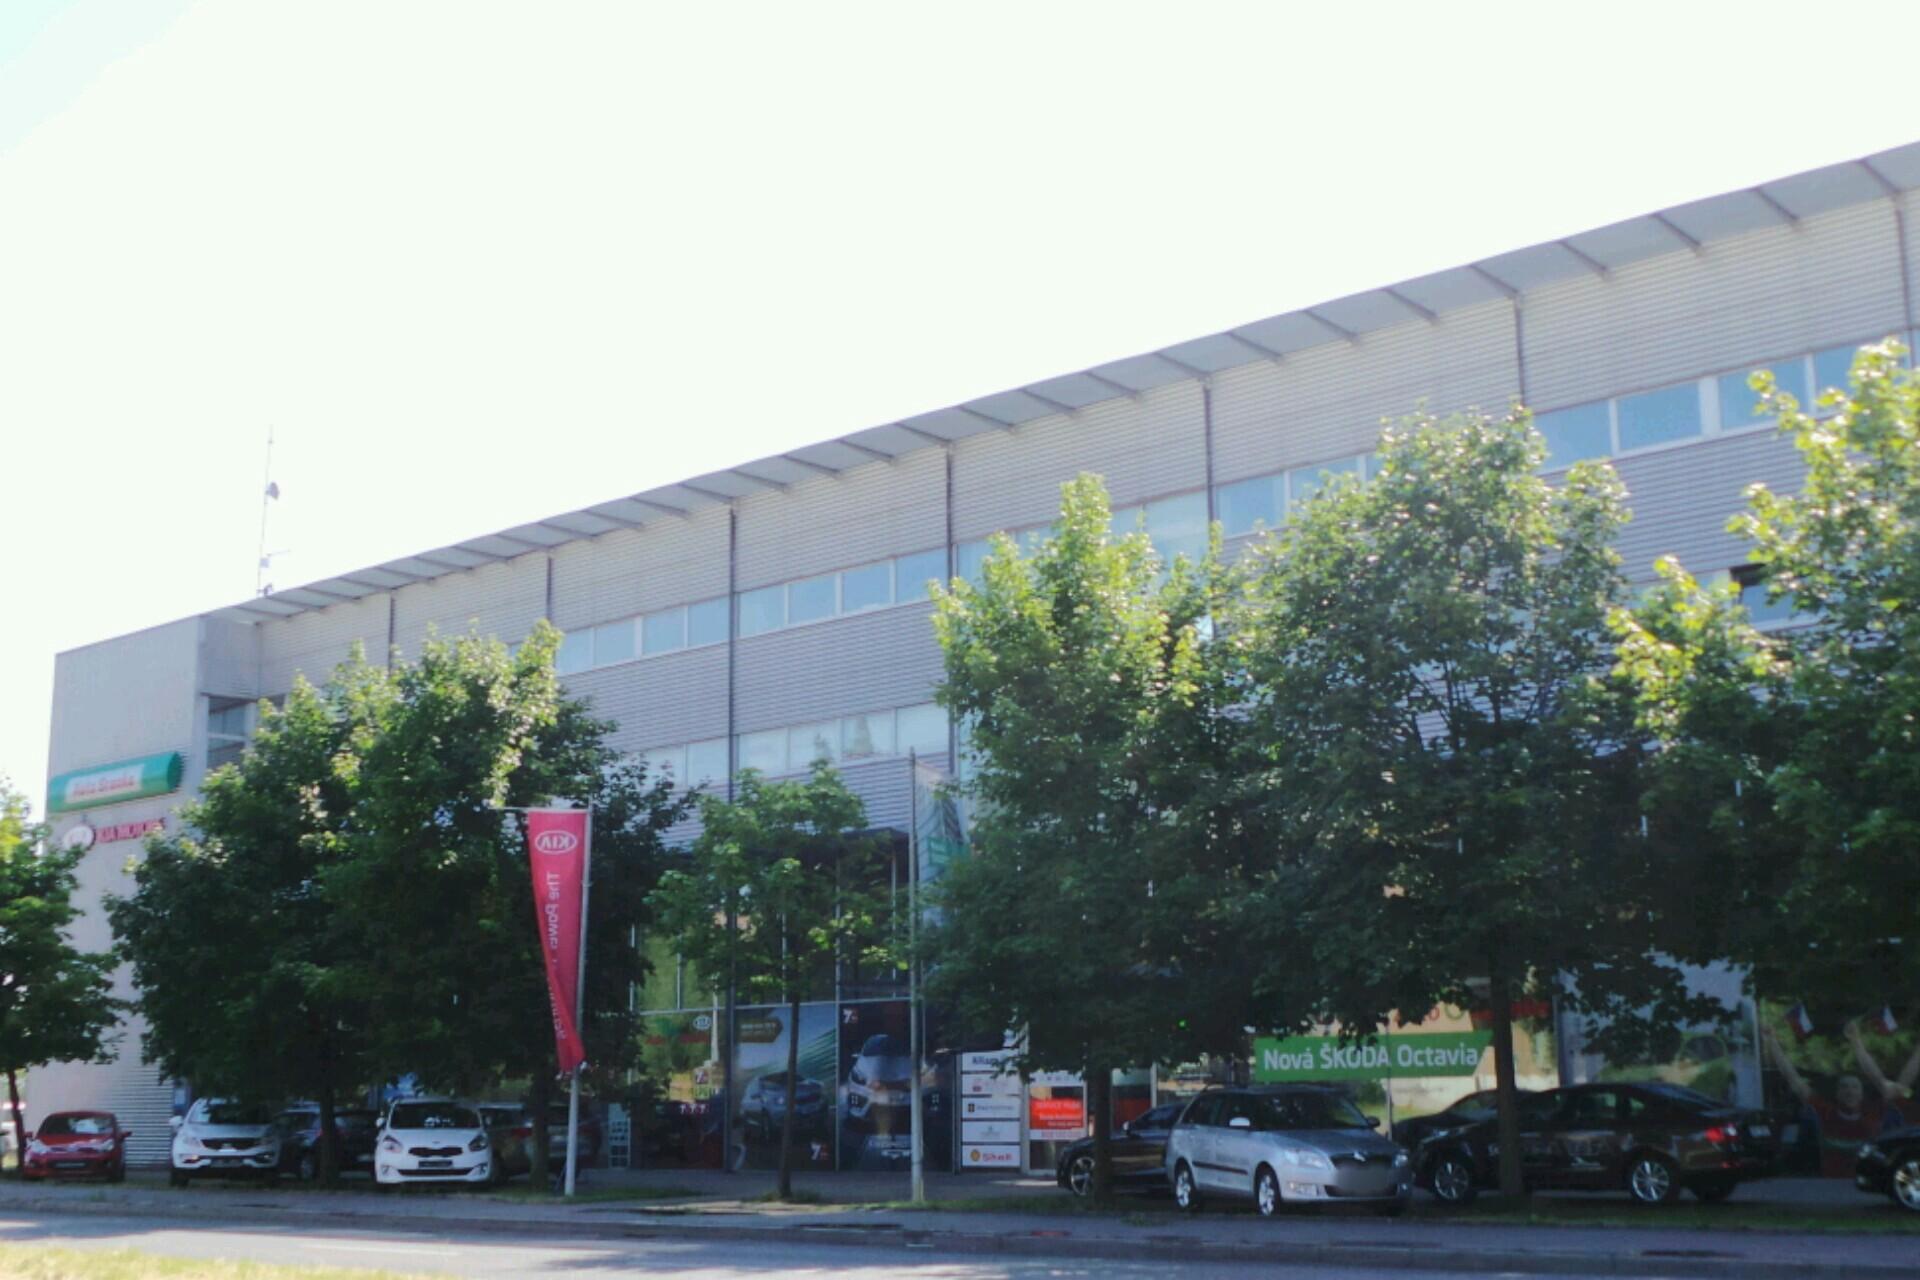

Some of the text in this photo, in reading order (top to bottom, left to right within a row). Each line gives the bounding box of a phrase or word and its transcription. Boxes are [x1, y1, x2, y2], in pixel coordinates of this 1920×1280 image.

[1263, 1042, 1479, 1071] Nová ŠKODA Octavia
[982, 1152, 1012, 1164] Shell
